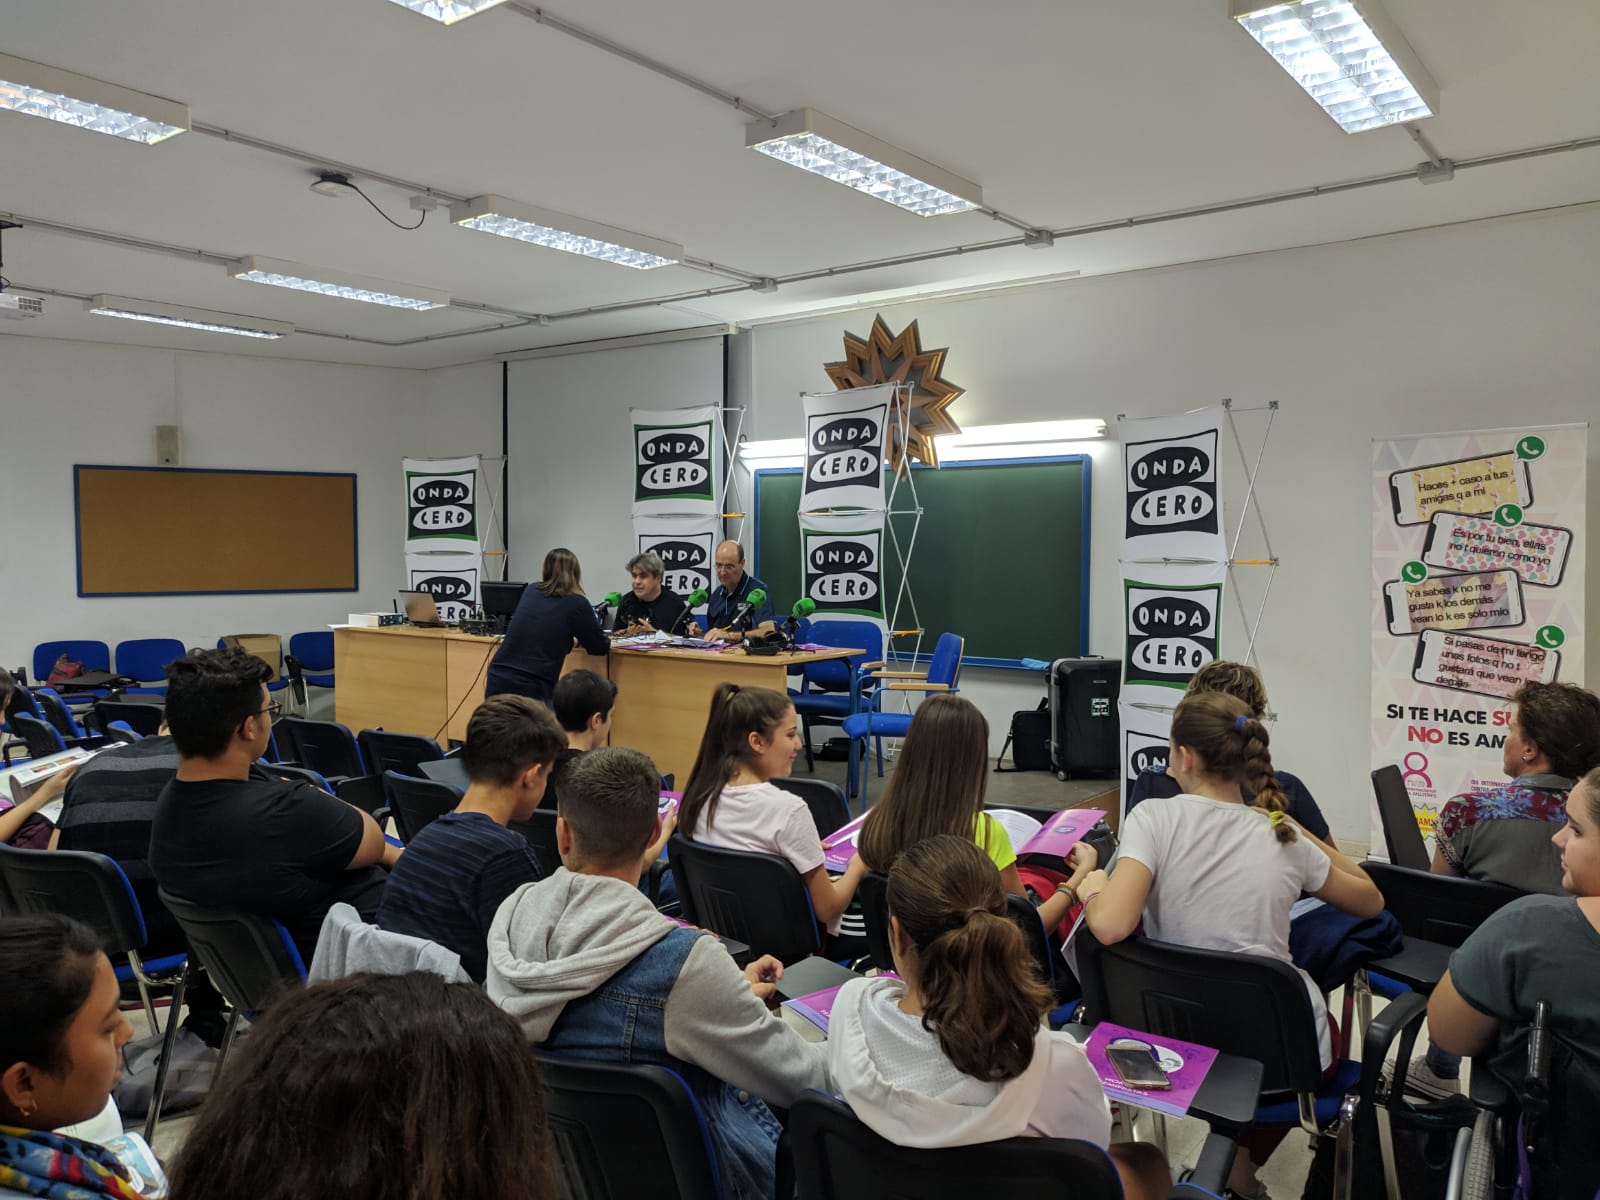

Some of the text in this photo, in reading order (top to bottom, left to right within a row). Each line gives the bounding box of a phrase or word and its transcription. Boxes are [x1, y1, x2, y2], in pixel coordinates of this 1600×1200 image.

[818, 425, 870, 444] ONDA
[647, 440, 698, 456] ONDA
[820, 455, 869, 476] CERO
[1137, 455, 1201, 480] ONDA
[650, 468, 698, 483] CERO
[1419, 482, 1448, 492] Haces
[1459, 475, 1482, 485] caso
[1493, 470, 1509, 480] tus
[418, 487, 464, 500] ONDA
[1421, 494, 1454, 505] amigas
[1142, 494, 1203, 518] CERO
[421, 511, 464, 524] CERO
[815, 550, 867, 564] ONDA
[665, 575, 700, 590] ERO
[820, 579, 868, 596] CERO
[1407, 590, 1420, 598] Ya
[1423, 585, 1450, 596] sabes
[1461, 584, 1473, 592] no
[1139, 607, 1203, 627] ONDA
[1456, 640, 1484, 650] pasas
[1142, 644, 1202, 668] CERO
[1387, 704, 1404, 719] SI
[1408, 707, 1428, 720] TE
[1434, 708, 1487, 725] HACE
[1408, 726, 1443, 743] NO
[1448, 732, 1469, 745] ES
